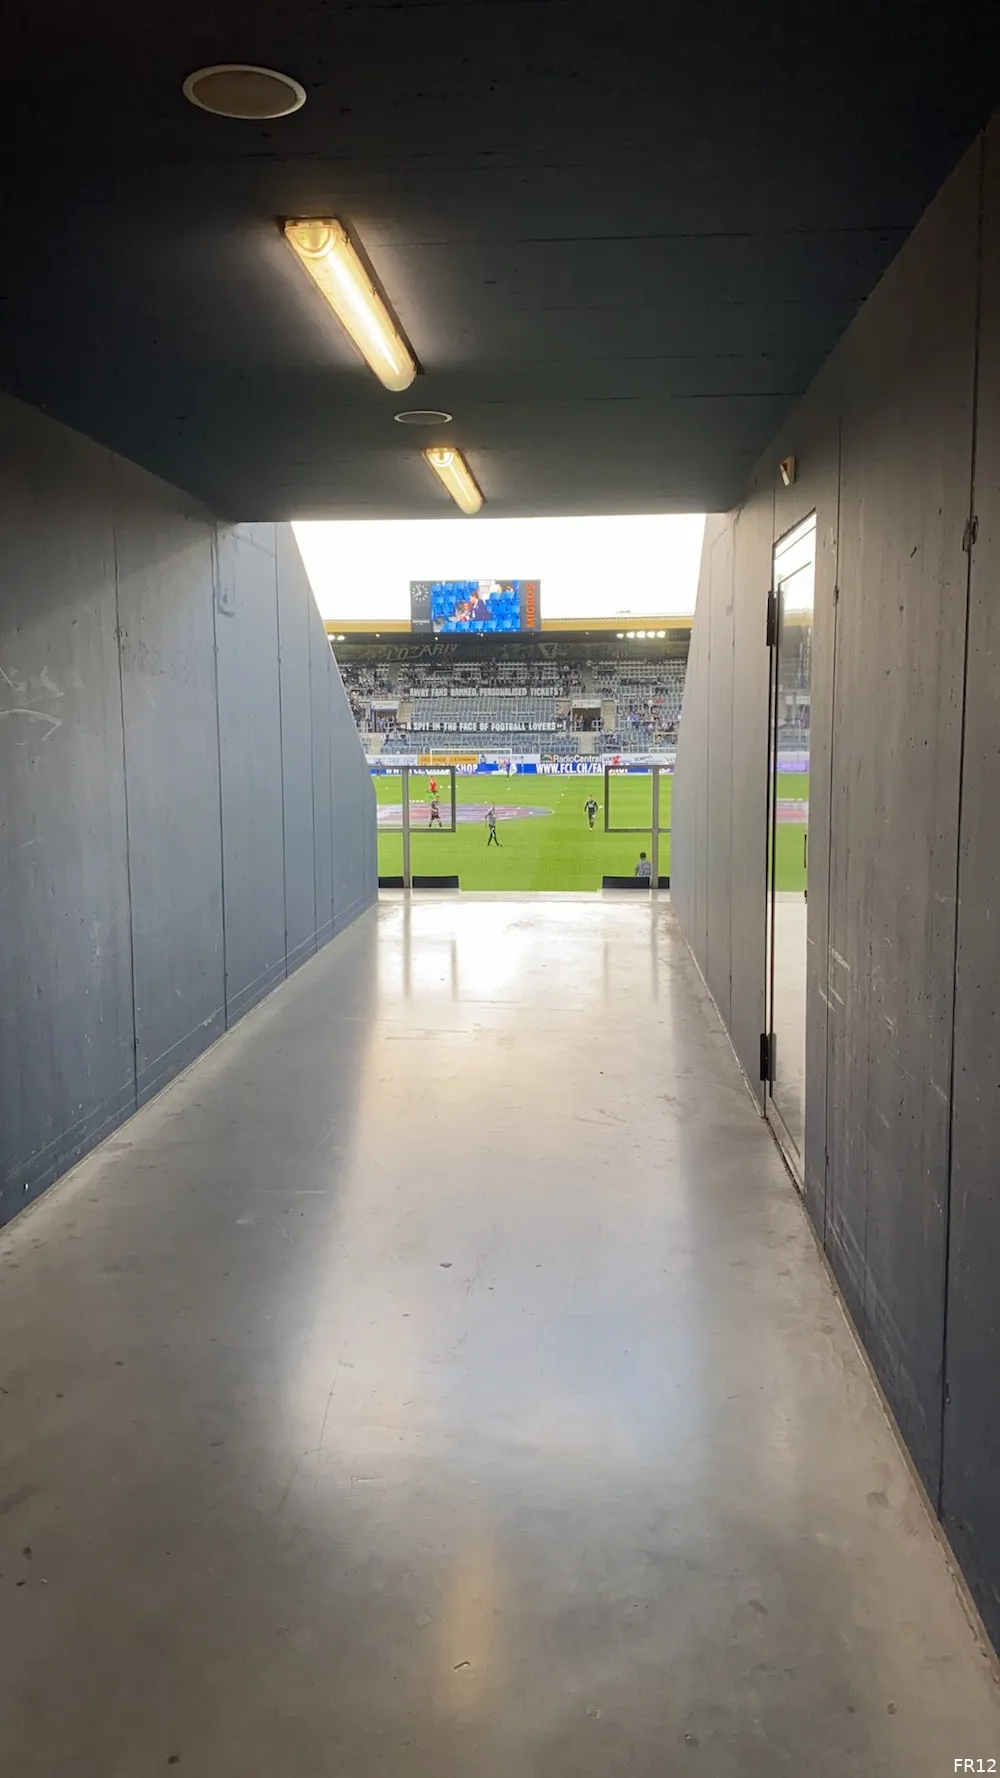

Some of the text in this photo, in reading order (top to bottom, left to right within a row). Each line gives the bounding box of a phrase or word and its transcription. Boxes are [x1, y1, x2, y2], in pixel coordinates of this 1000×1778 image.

[526, 583, 535, 628] MIGROS
[410, 688, 429, 697] AWAY
[431, 688, 447, 697] FANS
[480, 687, 527, 697] PERSONALISED
[530, 687, 564, 696] TICKETS?
[413, 722, 430, 730] SPIT
[433, 722, 440, 730] IN
[443, 722, 457, 731] THE
[460, 722, 477, 731] FACE
[480, 722, 489, 731] OF
[491, 722, 525, 731] FOOTBALL
[553, 754, 602, 763] RadioCentral
